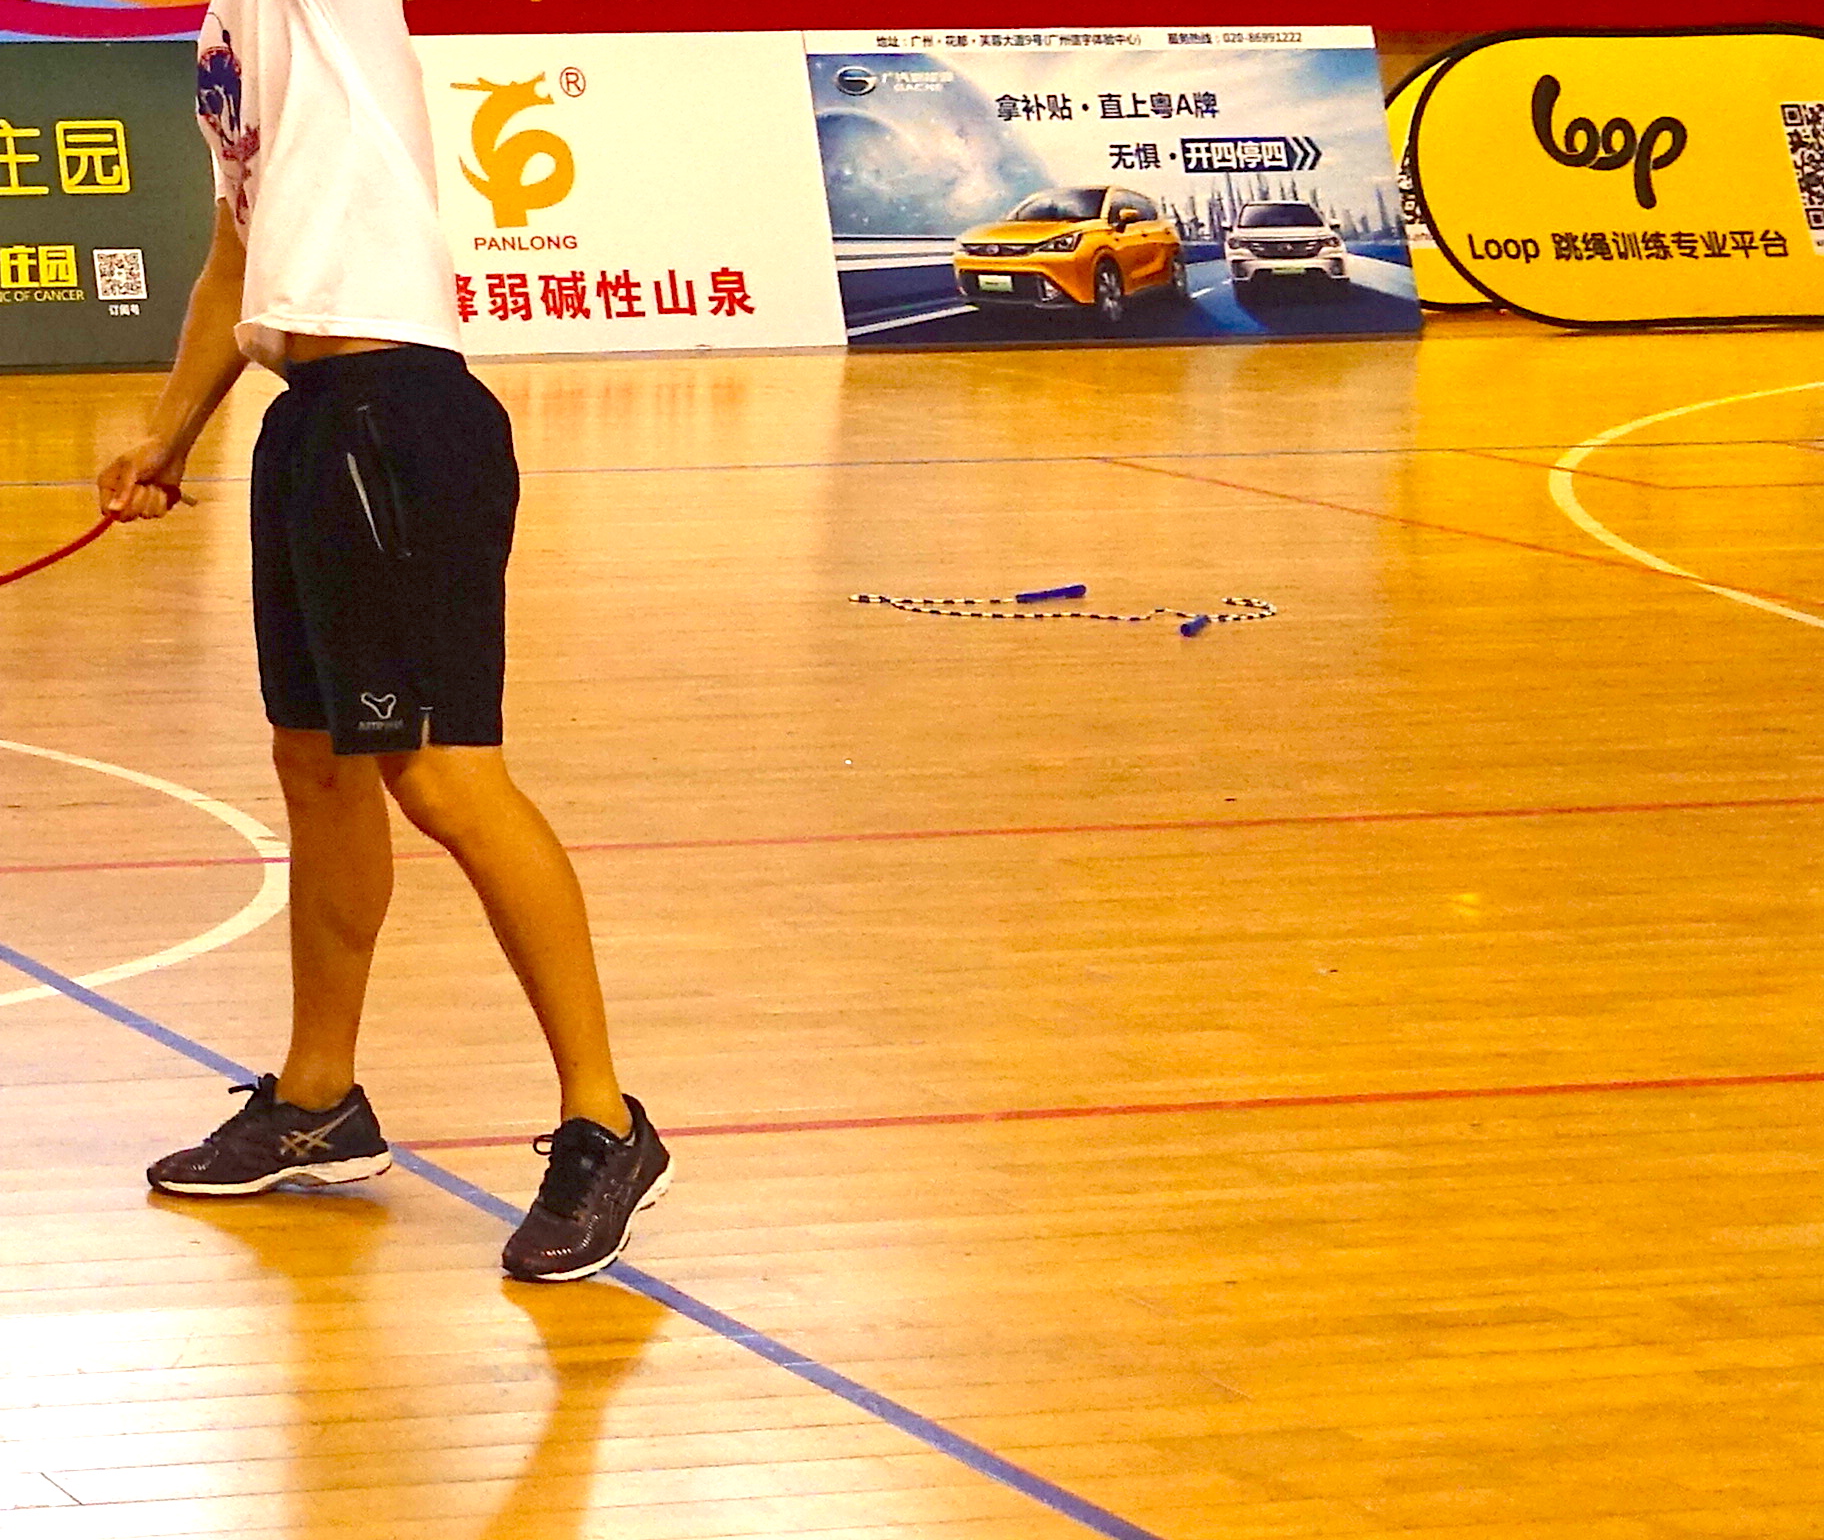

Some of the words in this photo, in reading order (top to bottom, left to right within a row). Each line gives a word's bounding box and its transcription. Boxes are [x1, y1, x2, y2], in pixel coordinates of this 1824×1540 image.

[473, 234, 578, 251] PANLONG
[1467, 232, 1541, 264] Loop
[1551, 228, 1789, 262] 跳绳训练专业平台
[13, 290, 30, 303] OF
[33, 288, 85, 302] CANCER
